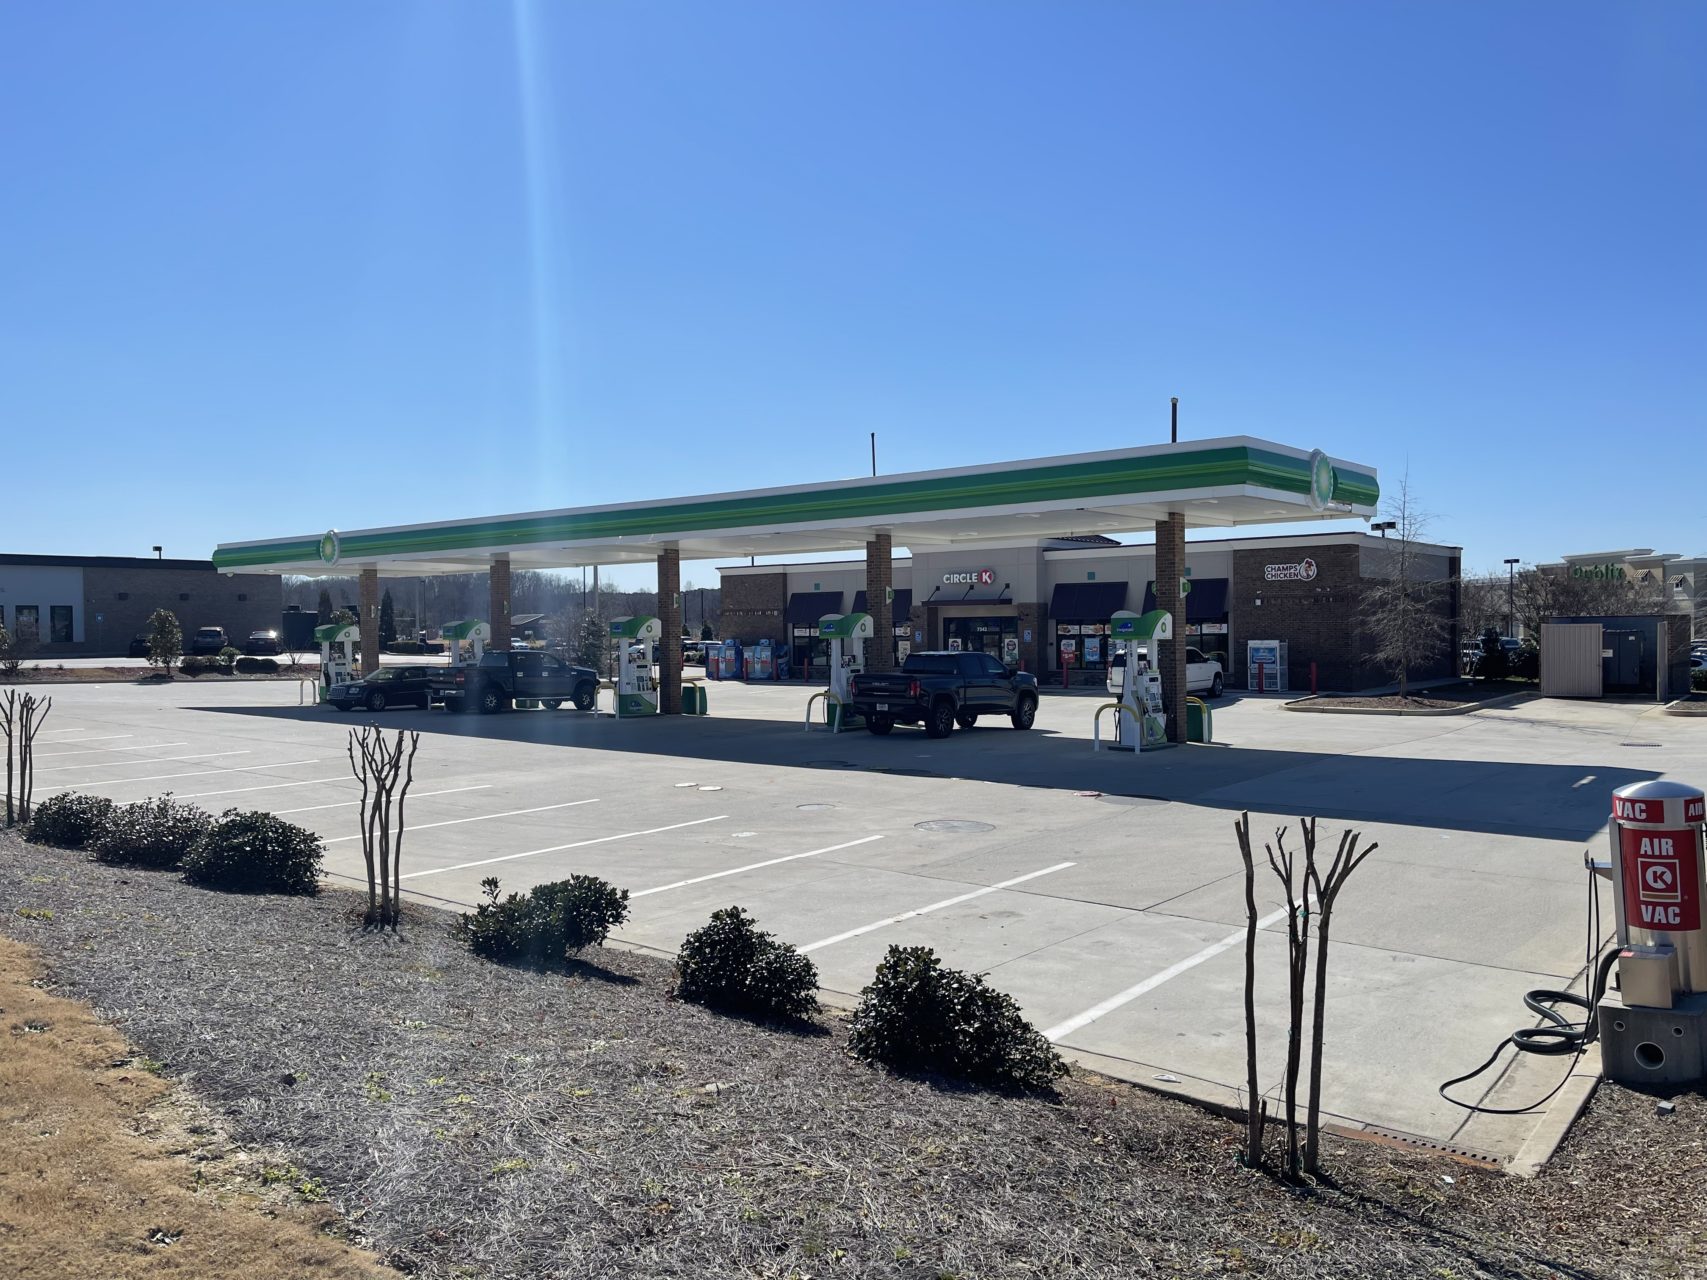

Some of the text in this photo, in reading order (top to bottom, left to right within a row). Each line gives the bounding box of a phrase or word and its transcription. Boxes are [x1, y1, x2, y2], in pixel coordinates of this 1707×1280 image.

[943, 572, 992, 584] CIRCLE K
[1265, 565, 1298, 573] CHAMPS
[1615, 800, 1647, 820] VAC
[1640, 838, 1673, 856] AIR
[1652, 870, 1671, 889] K
[1640, 904, 1681, 925] VAC
